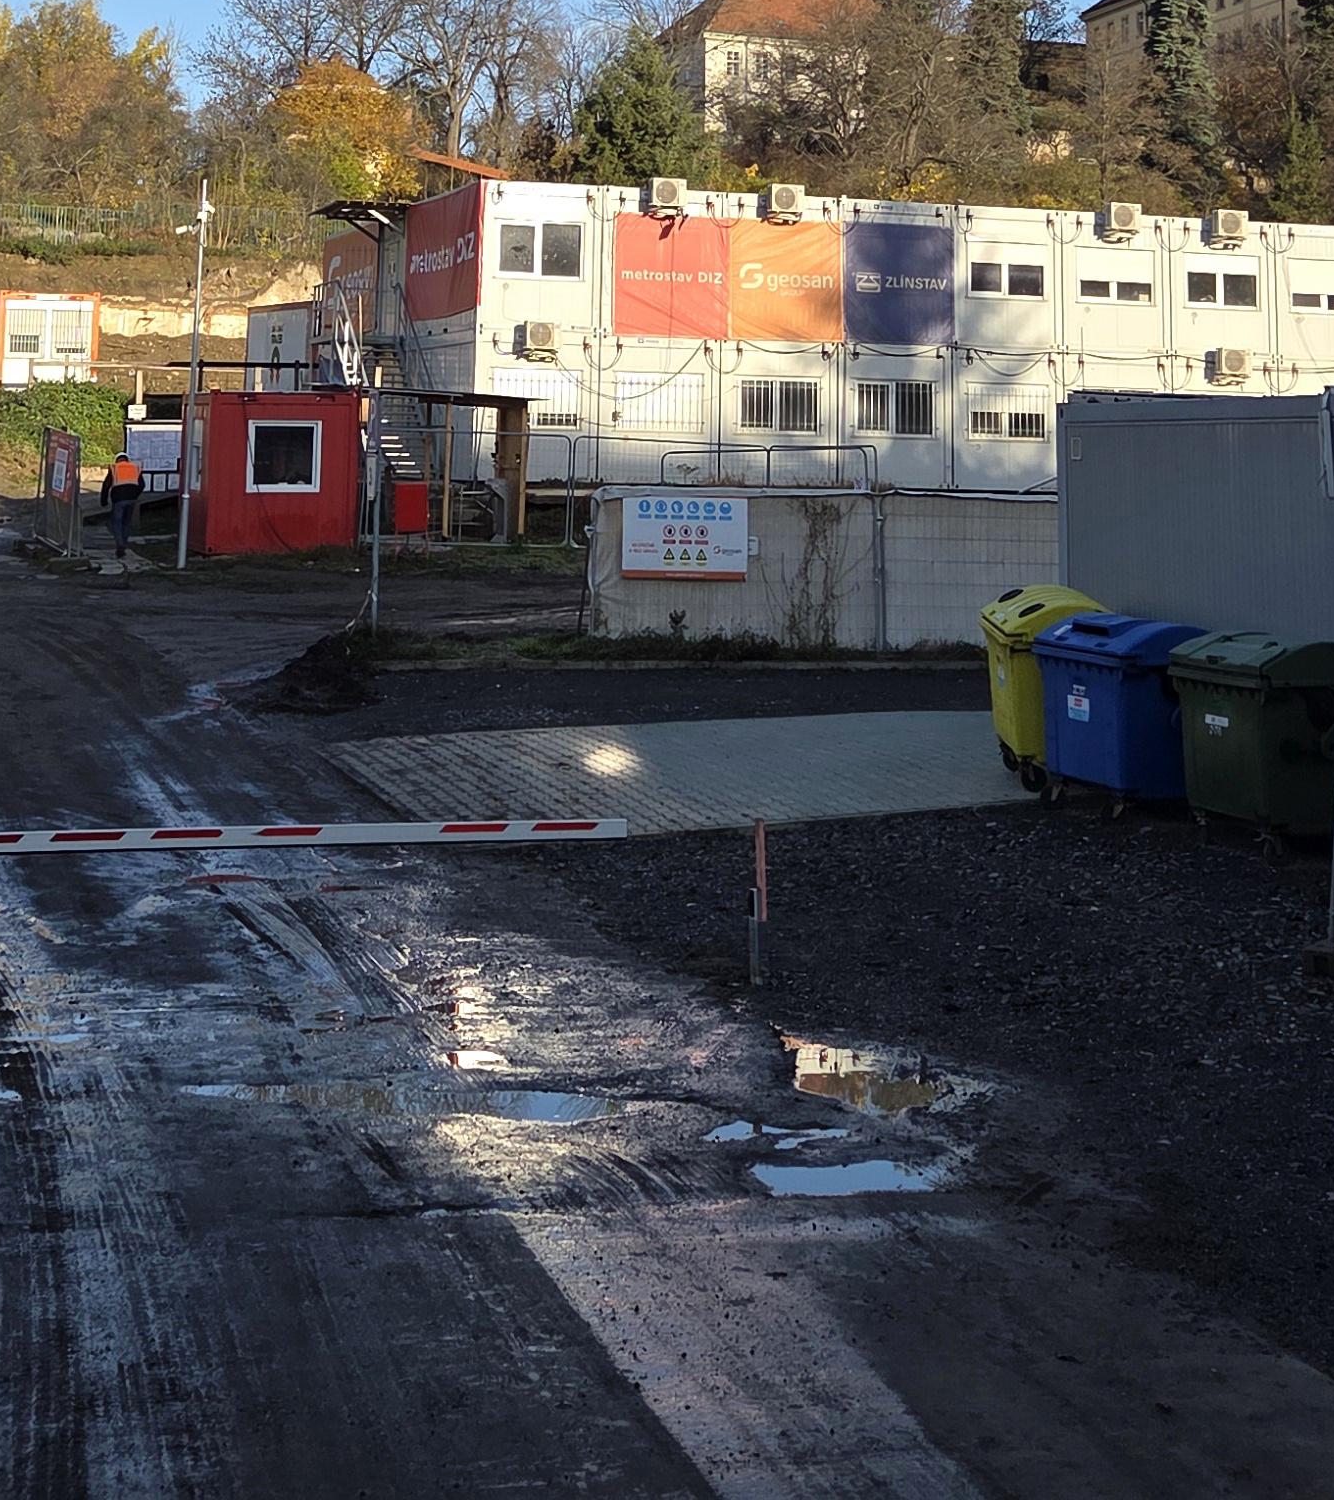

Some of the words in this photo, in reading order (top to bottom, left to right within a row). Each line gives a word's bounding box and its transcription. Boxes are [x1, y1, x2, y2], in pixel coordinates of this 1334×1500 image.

[621, 269, 693, 283] metrostav
[698, 271, 723, 284] DIZ
[767, 273, 834, 291] geosan
[885, 274, 947, 291] ZLÍNSTAV
